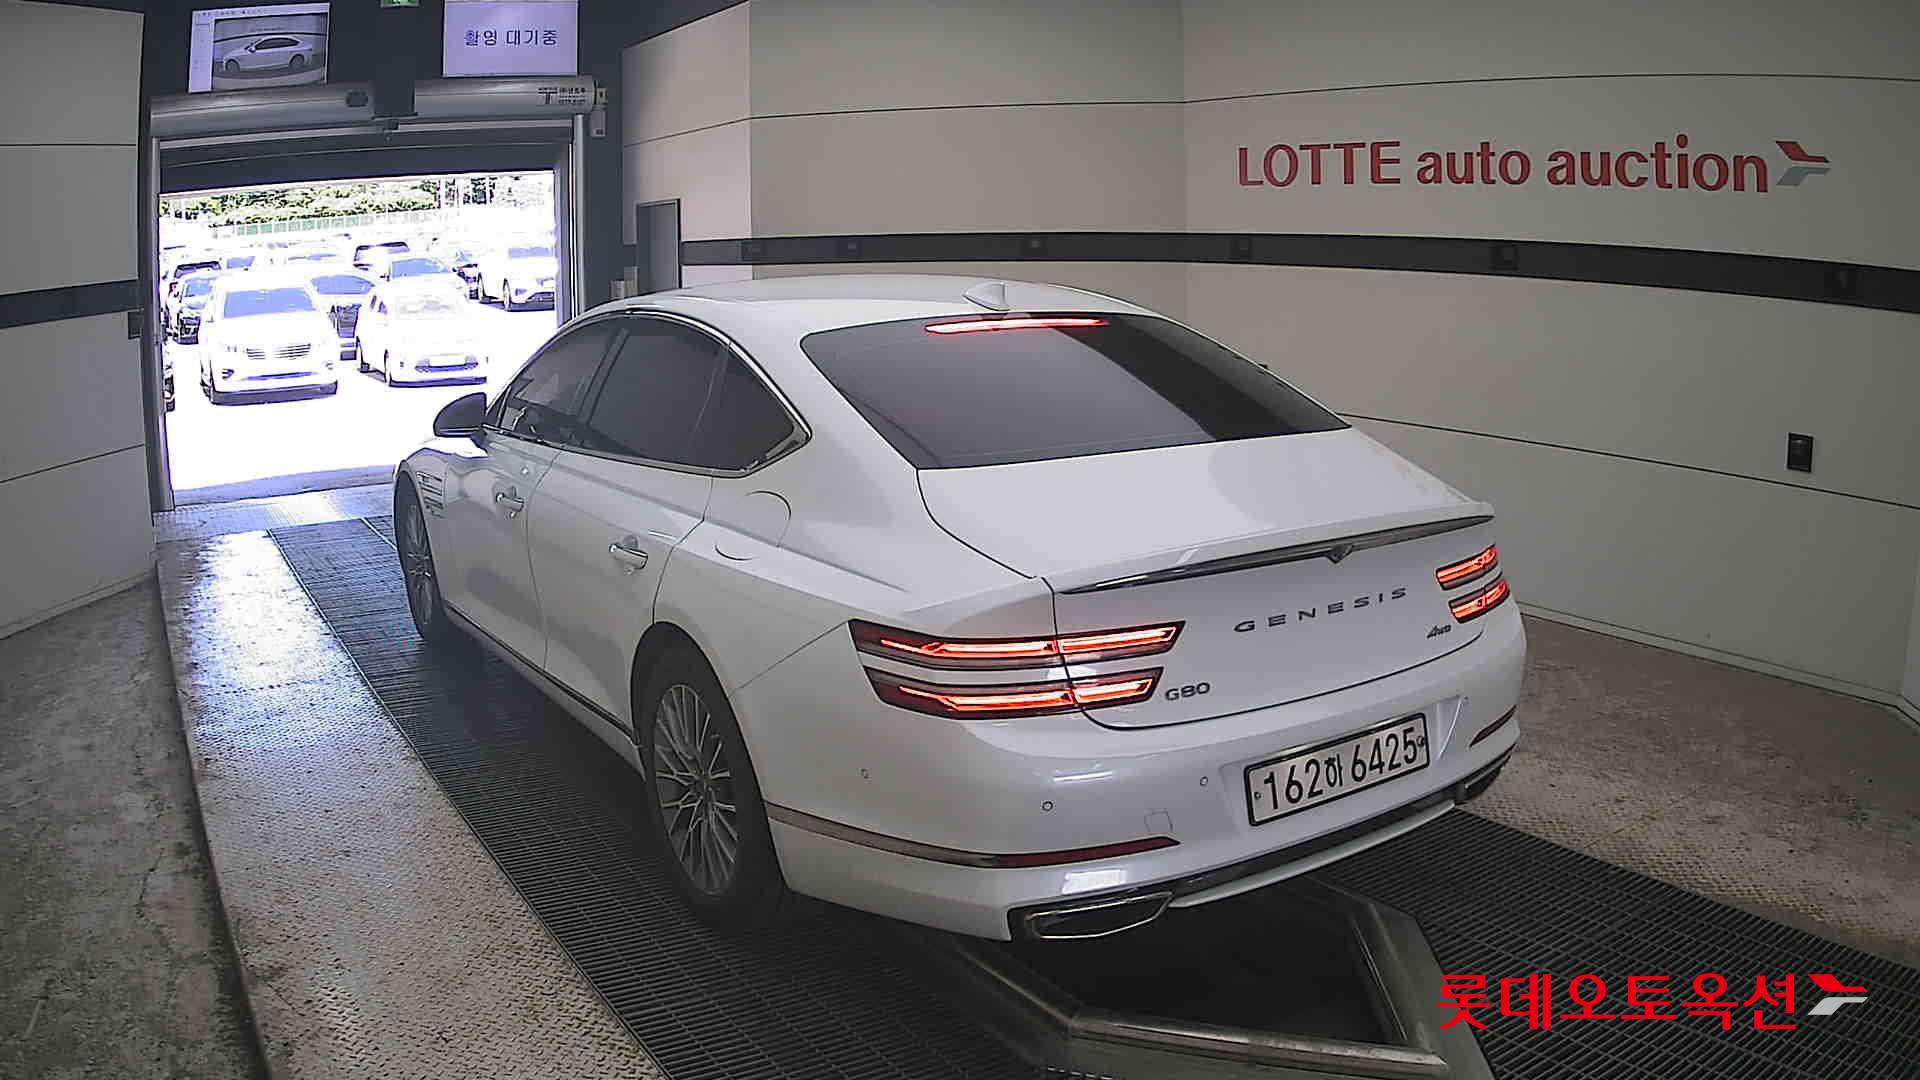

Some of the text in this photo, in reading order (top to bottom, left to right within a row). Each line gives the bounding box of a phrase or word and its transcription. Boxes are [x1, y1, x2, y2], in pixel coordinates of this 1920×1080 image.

[506, 29, 557, 46] 대기중
[1239, 133, 1768, 193] LOTTE auto auction
[1234, 587, 1407, 633] GENESIS
[1165, 682, 1211, 701] G80
[1263, 726, 1418, 810] 162하 6425
